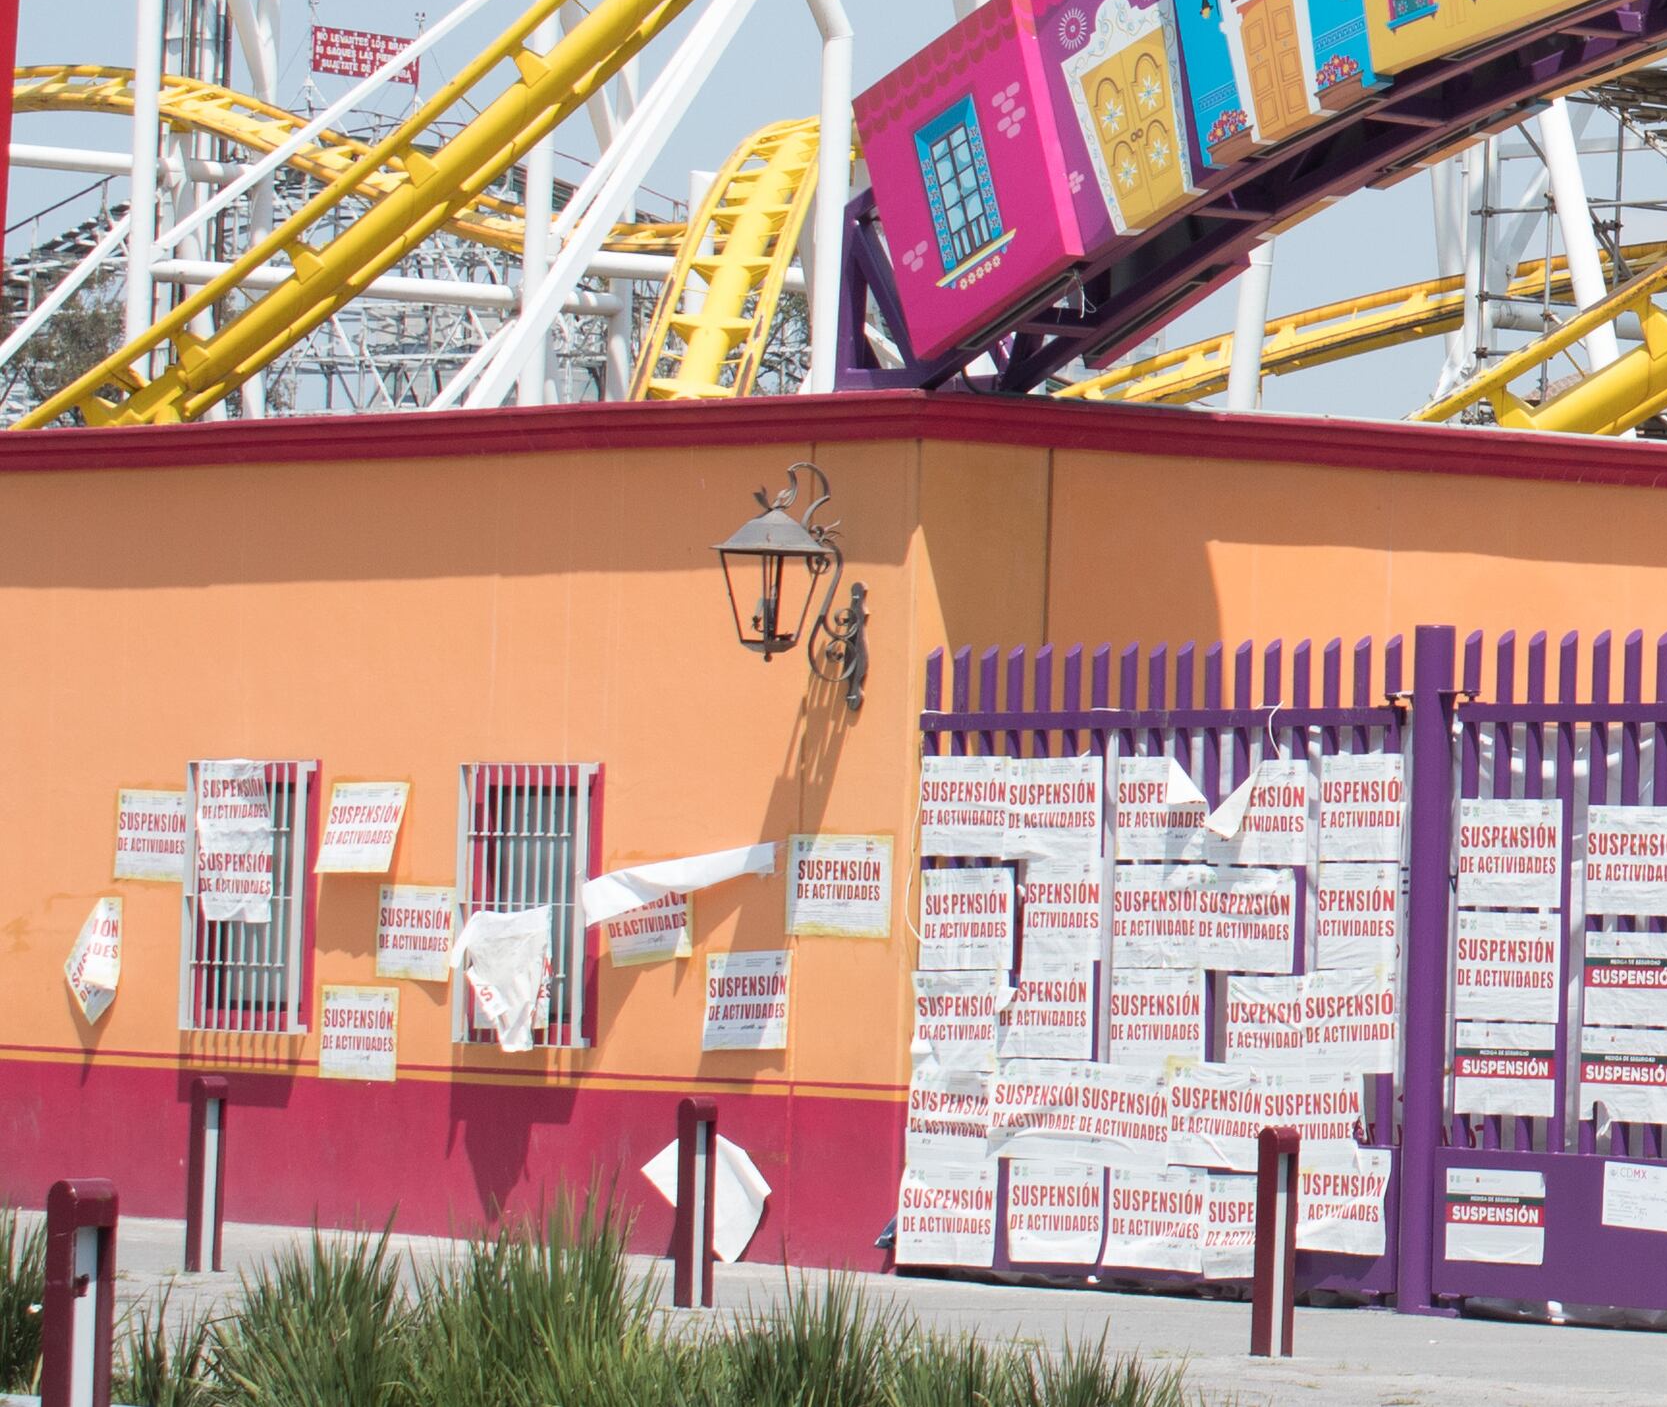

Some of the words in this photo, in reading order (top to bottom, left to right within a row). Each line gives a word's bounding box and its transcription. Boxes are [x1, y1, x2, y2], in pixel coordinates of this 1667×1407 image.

[922, 778, 1006, 802] SUSPENSIÓN
[1010, 779, 1095, 805] SUSPENSIÓN
[120, 811, 186, 833] SUSPENSIÓN
[330, 802, 401, 825] SUSPENSIÓN
[922, 810, 934, 825] DE
[937, 810, 1005, 826] ACTIVIDADES
[1008, 812, 1020, 829] DE
[1024, 811, 1095, 828] ACTIVIDADES
[325, 831, 335, 844] DE
[336, 829, 393, 845] ACTIVIDADES
[1461, 822, 1556, 848] SUSPENSIÓN
[118, 838, 128, 851] DE
[131, 838, 185, 855] ACTIVIDADES
[798, 857, 880, 882] SUSPENSIÓN
[1460, 856, 1473, 873] DE
[1478, 856, 1555, 874] ACTIVIDADES
[1588, 864, 1601, 881] DE
[797, 883, 810, 899] DE
[812, 884, 880, 902] ACTIVIDADES
[926, 889, 1007, 915] SUSPENSIÓN
[1200, 887, 1290, 916] SUSPENSIÓN
[380, 904, 450, 930] SUSPENSIÓN
[925, 923, 937, 938] DE
[939, 921, 1006, 938] ACTIVIDADES
[1200, 920, 1212, 937] DE
[1216, 920, 1289, 941] ACTIVIDADES
[379, 934, 390, 948] DE
[392, 934, 448, 952] ACTIVIDADES
[1458, 937, 1554, 963] SUSPENSIÓN
[709, 971, 787, 998] SUSPENSIÓN
[1457, 969, 1471, 985] DE
[1475, 969, 1553, 989] ACTIVIDADES
[708, 1005, 720, 1021] DE
[722, 1002, 784, 1020] ACTIVIDADES
[1111, 991, 1199, 1016] SUSPENSIÓN
[324, 1007, 393, 1030] SUSPENSIÓN
[1111, 1024, 1124, 1040] DE
[1127, 1024, 1199, 1040] ACTIVIDADES
[323, 1036, 332, 1049] DE
[334, 1036, 393, 1052] ACTIVIDADES
[1462, 1058, 1548, 1076] SUSPENSIÓN
[1083, 1086, 1168, 1118] SUSPENSIÓN
[1172, 1086, 1261, 1115] SUSPENSIÓN
[1079, 1115, 1092, 1132] DE
[1095, 1117, 1168, 1142] ACTIVIDADES
[1172, 1115, 1186, 1132] DE
[1188, 1116, 1259, 1139] ACTIVIDADES
[1620, 1167, 1647, 1180] CDMX
[903, 1186, 993, 1211] SUSPENSIÓN
[1012, 1182, 1099, 1207] SUSPENSIÓN
[1113, 1188, 1202, 1215] SUSPENSIÓN
[1010, 1214, 1024, 1230] DE
[1027, 1214, 1098, 1232] ACTIVIDADES
[1452, 1205, 1538, 1223] SUSPENSIÓN
[903, 1217, 915, 1232] DE
[919, 1217, 990, 1235] ACTIVIDADES
[1112, 1218, 1125, 1234] DE
